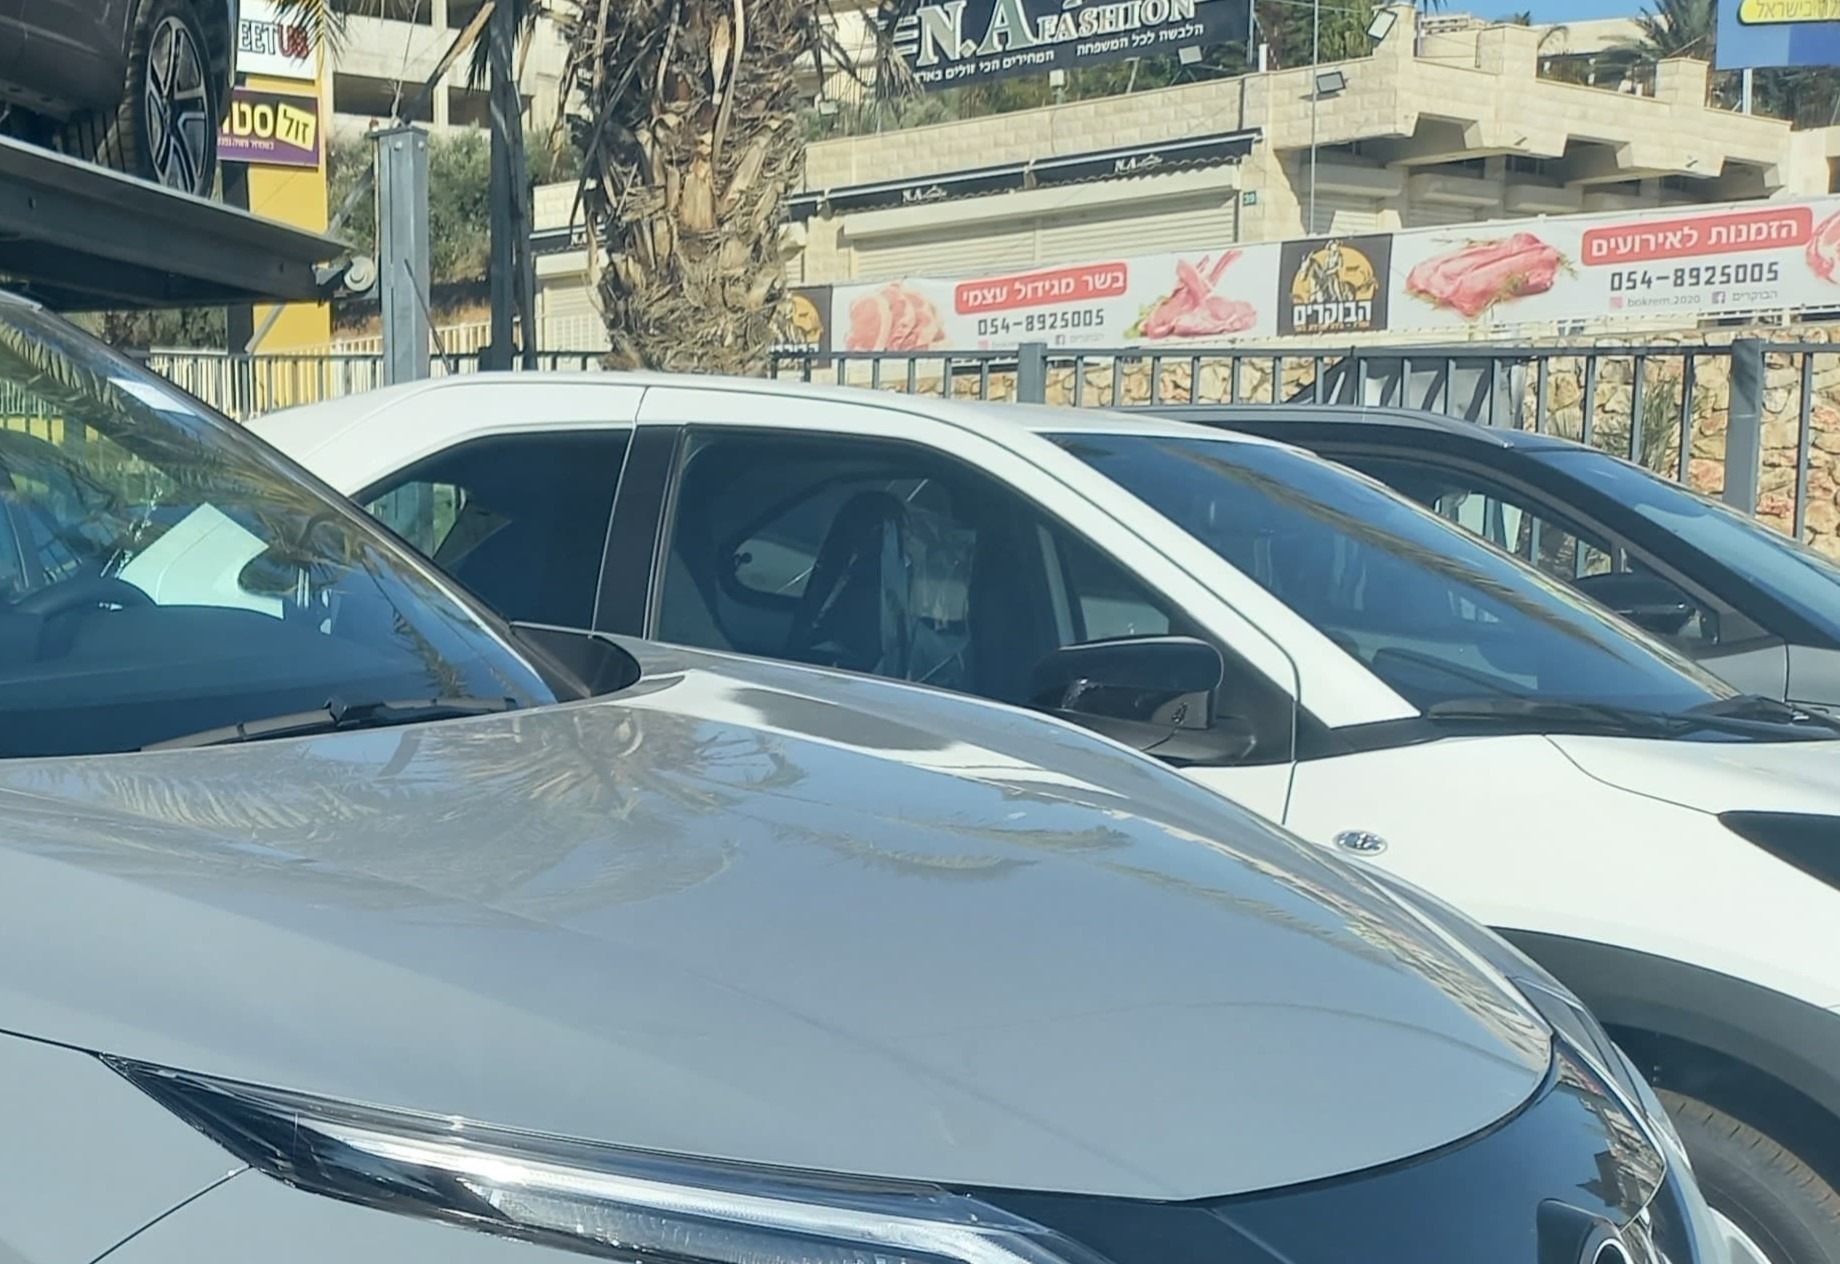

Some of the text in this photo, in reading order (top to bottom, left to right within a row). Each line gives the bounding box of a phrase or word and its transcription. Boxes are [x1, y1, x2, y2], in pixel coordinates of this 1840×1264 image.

[1036, 0, 1196, 44] FASHION
[1132, 31, 1155, 47] לכל
[1591, 219, 1798, 257] הזמנות לאירועים
[962, 272, 1125, 307] בשר מגידול עצמי
[1610, 262, 1779, 291] 054-8925005
[977, 308, 1105, 336] 054-8925005
[1293, 300, 1372, 327] הבוקרים
